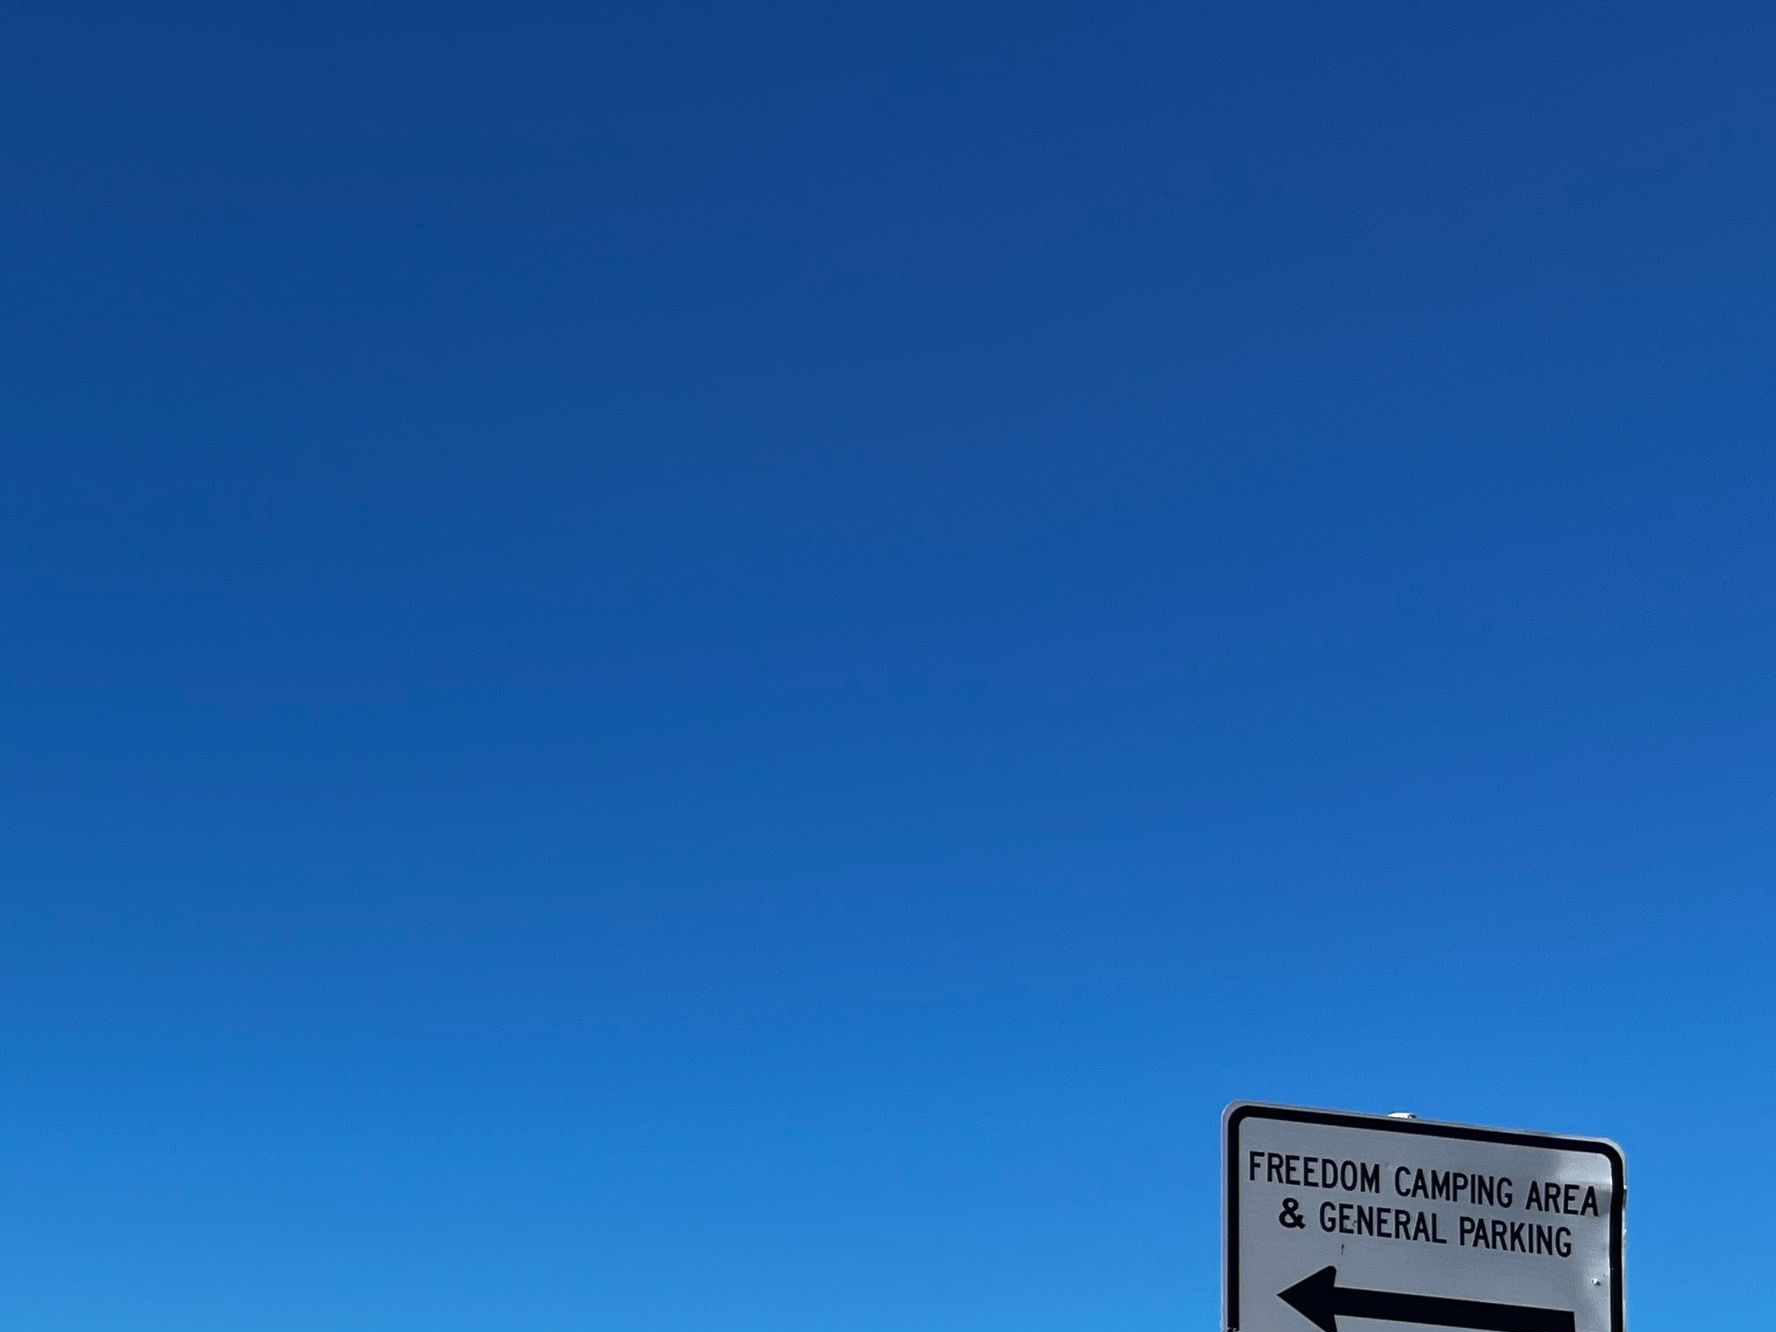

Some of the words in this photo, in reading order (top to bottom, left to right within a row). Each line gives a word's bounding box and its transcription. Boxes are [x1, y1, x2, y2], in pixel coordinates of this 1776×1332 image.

[1249, 1151, 1380, 1194] FREEDOM
[1395, 1166, 1513, 1208] CAMPING
[1525, 1181, 1599, 1217] AREA
[1278, 1197, 1306, 1229] &
[1319, 1201, 1447, 1244] GENERAL
[1459, 1216, 1572, 1258] PARKING
